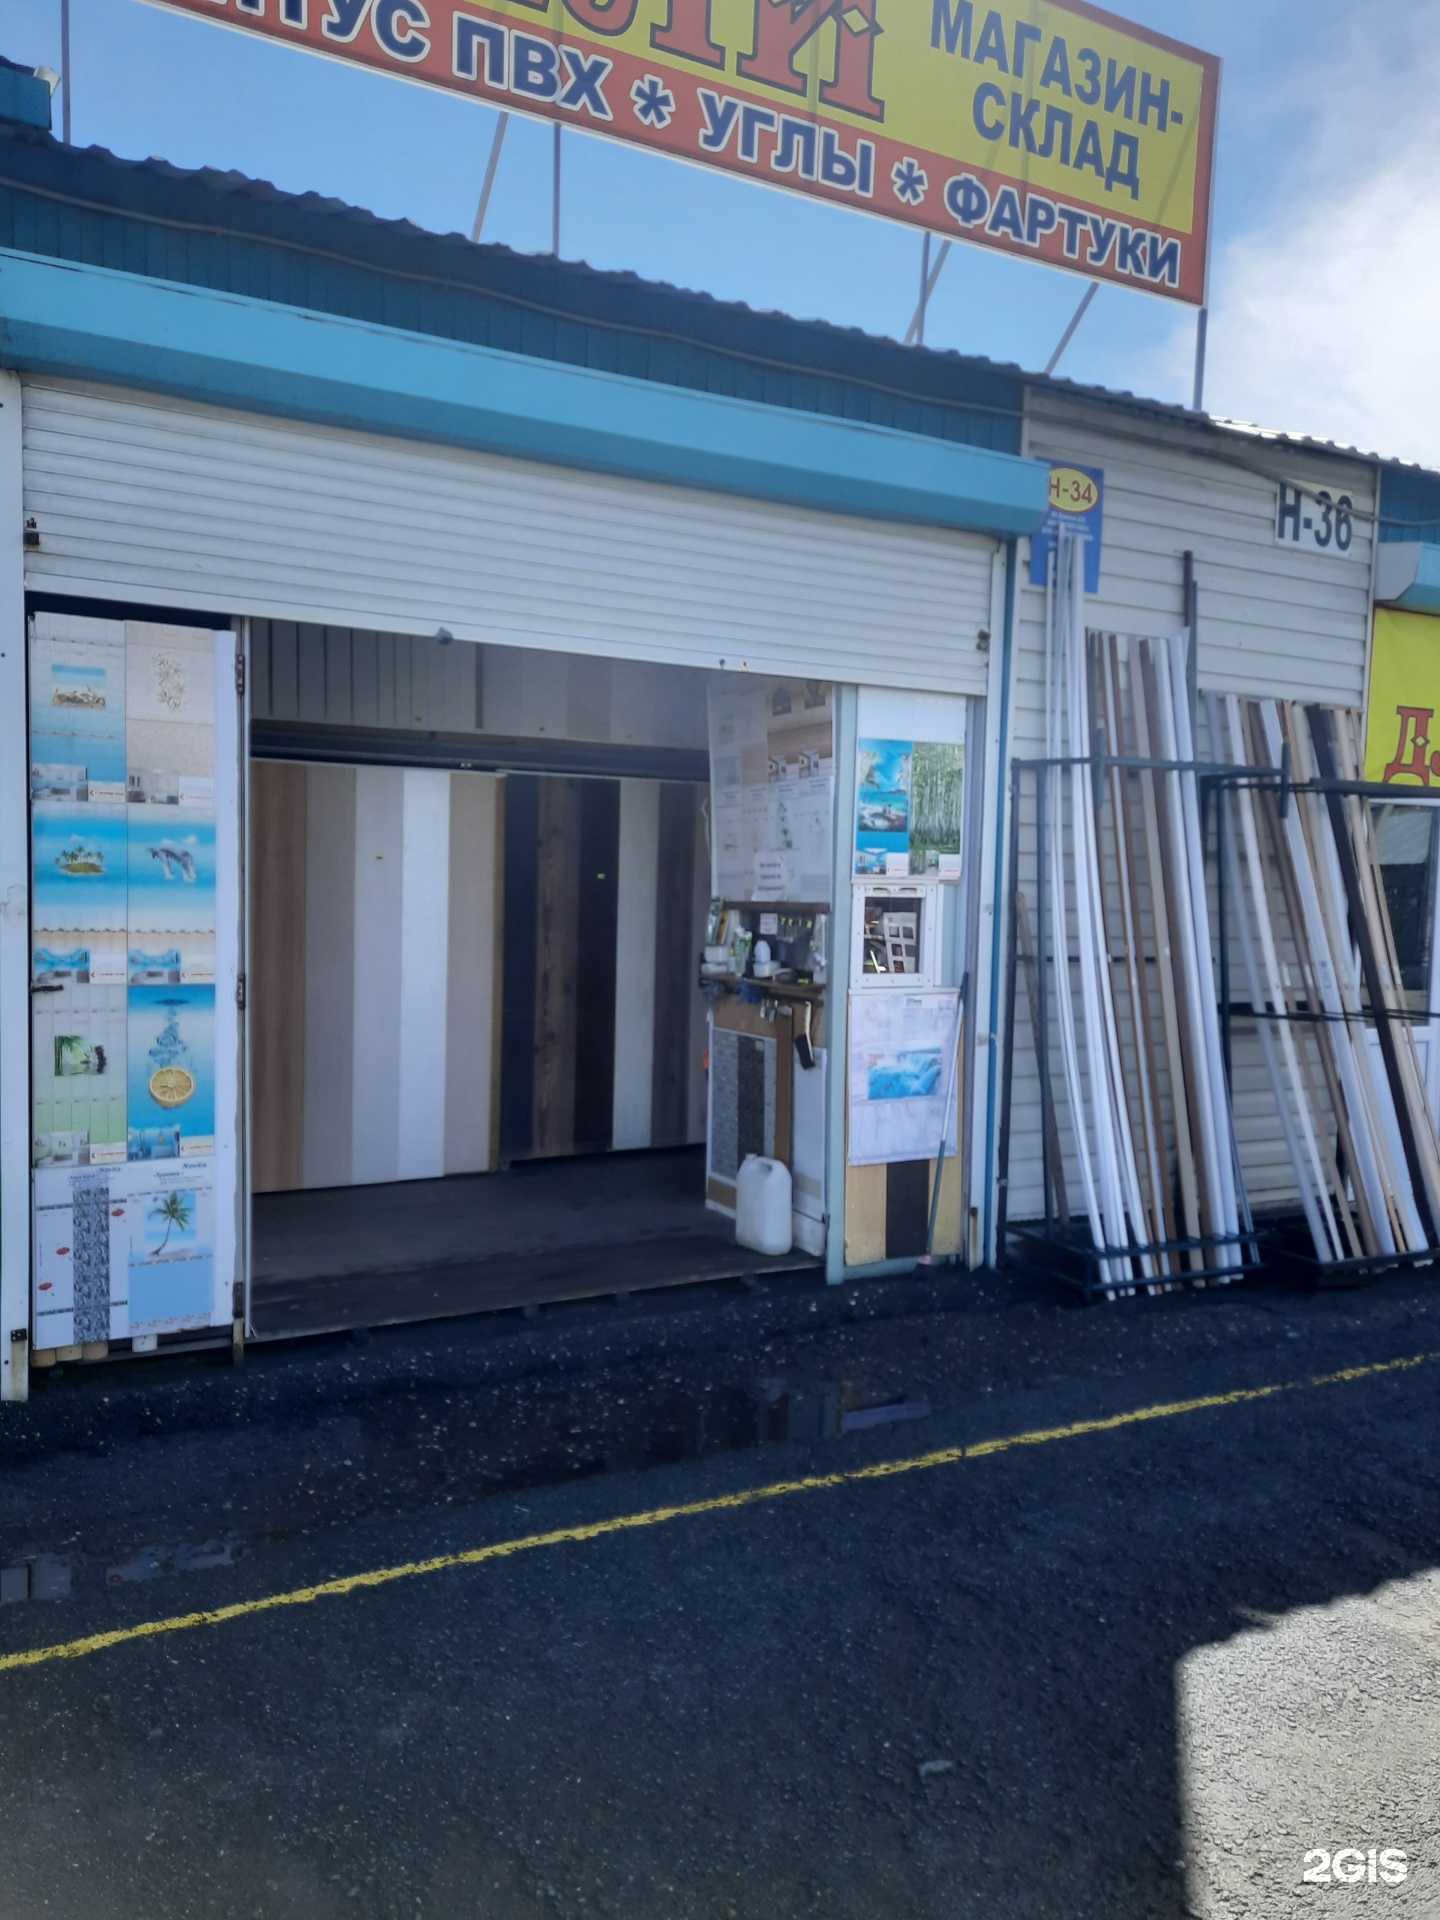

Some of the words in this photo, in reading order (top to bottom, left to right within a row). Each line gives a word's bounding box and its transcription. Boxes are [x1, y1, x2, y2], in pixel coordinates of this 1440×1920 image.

[930, 0, 1184, 134] МАГАЗИН-
[453, 10, 614, 120] ПВХ
[698, 88, 876, 198] УГЛЫ
[944, 172, 1181, 287] ФАРТУКИ
[972, 81, 1140, 201] СКЛАД
